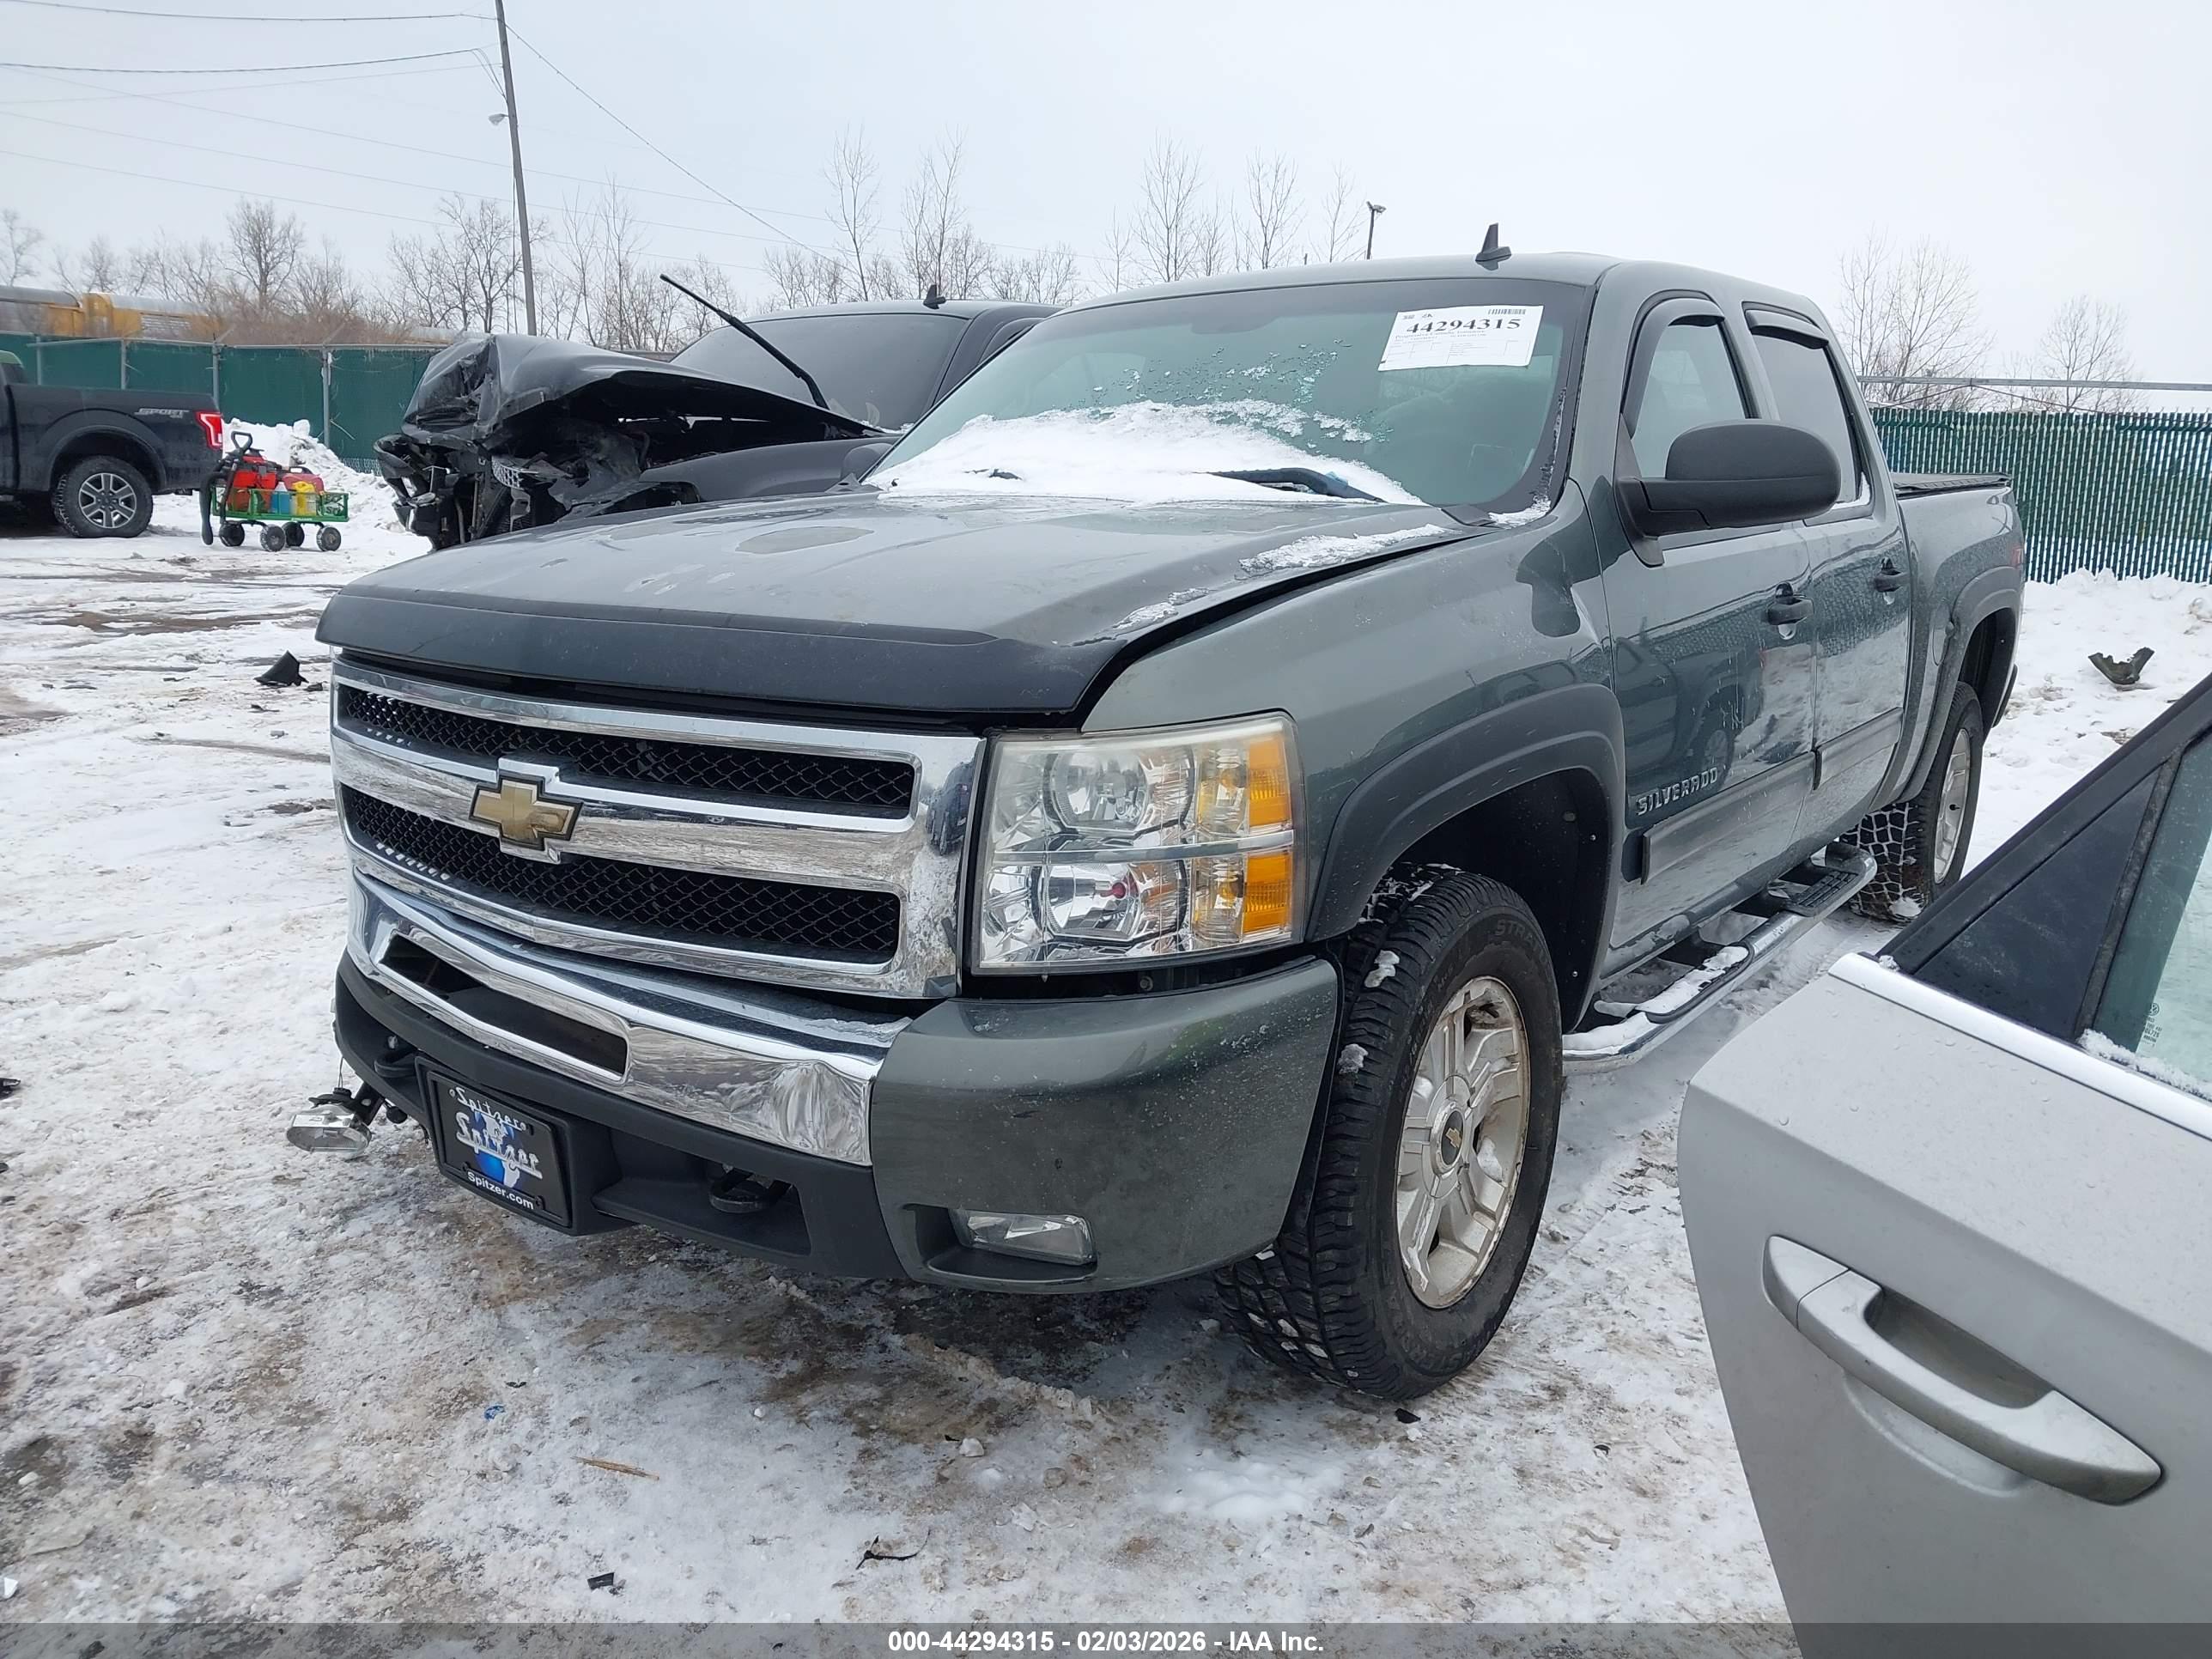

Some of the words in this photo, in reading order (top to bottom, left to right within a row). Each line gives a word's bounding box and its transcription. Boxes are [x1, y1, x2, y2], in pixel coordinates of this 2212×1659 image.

[1407, 319, 1522, 334] 44294315
[1637, 767, 1718, 816] SILVERADO
[455, 1086, 522, 1131] Spitzer
[455, 1111, 543, 1180] Spitzer
[467, 1170, 534, 1210] Spitzer.com
